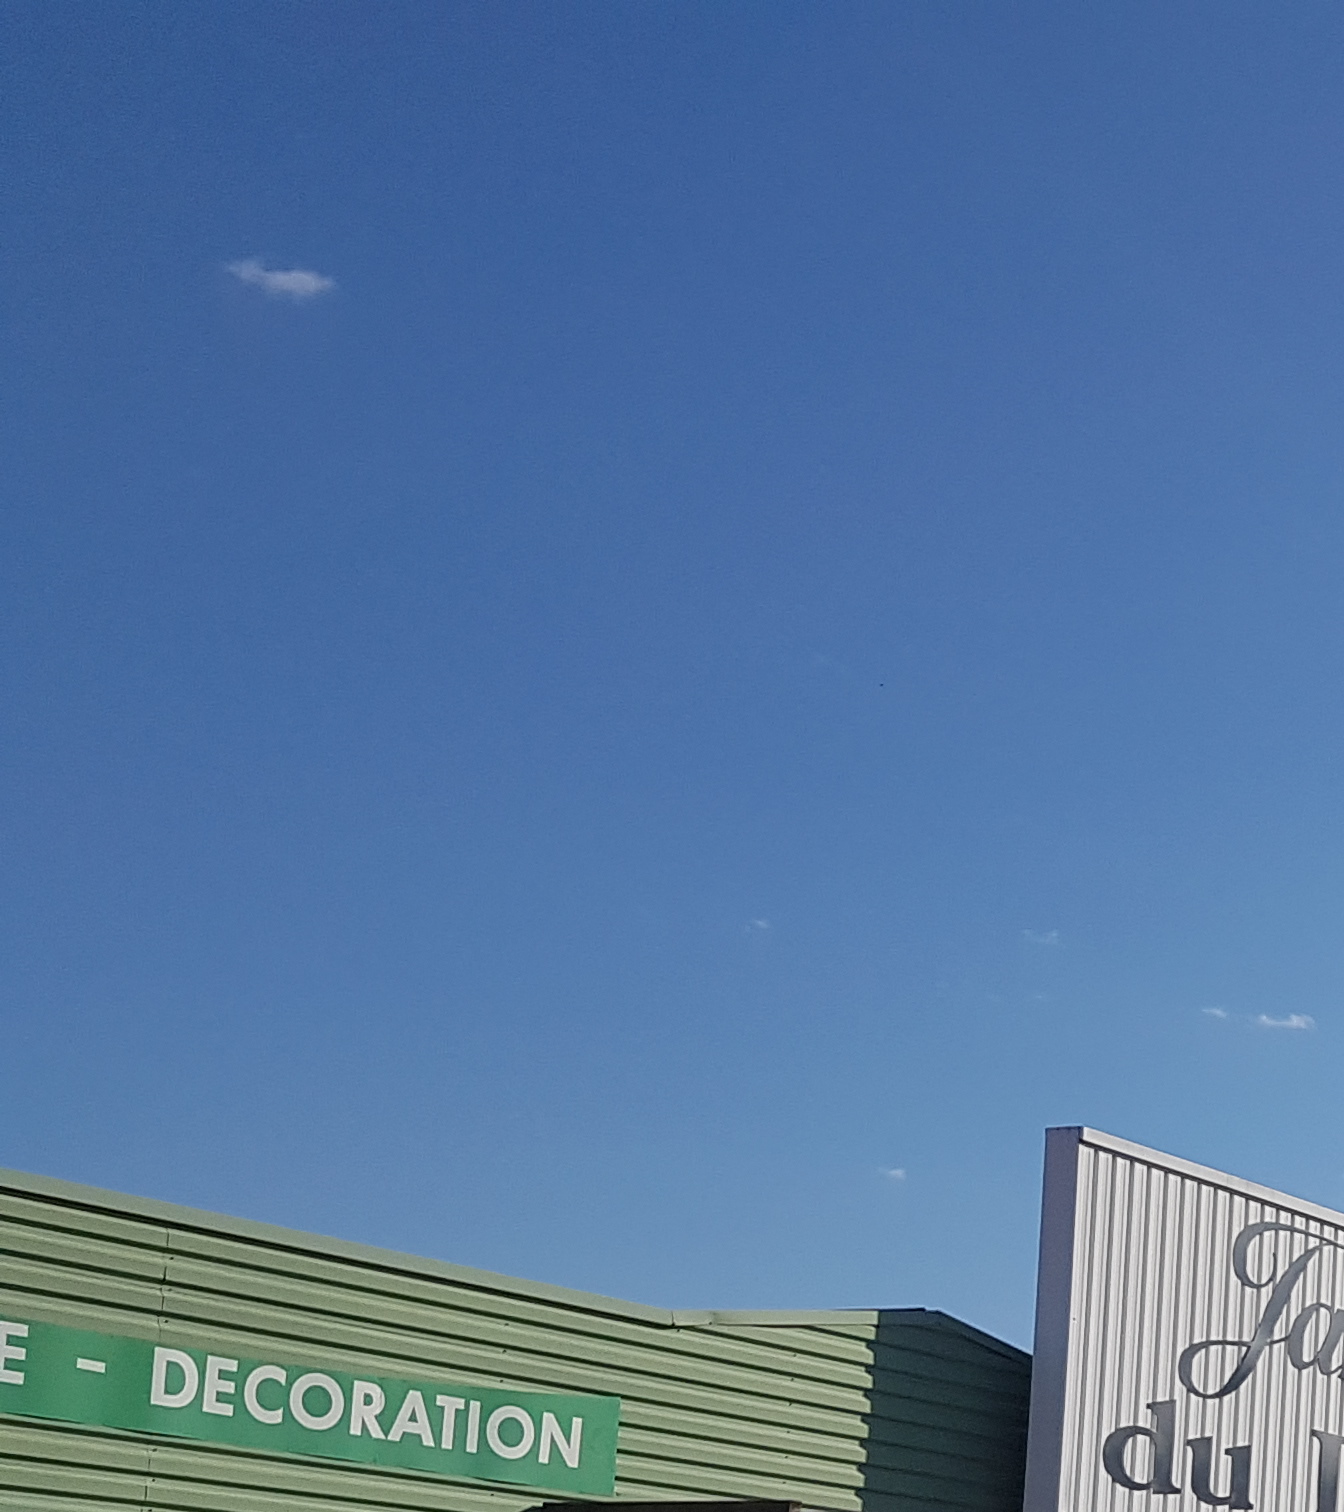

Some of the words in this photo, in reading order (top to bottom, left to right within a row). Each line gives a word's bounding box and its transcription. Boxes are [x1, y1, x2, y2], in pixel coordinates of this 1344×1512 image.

[0, 1320, 29, 1385] E
[150, 1346, 582, 1468] DECORATION
[1102, 1399, 1254, 1510] du
